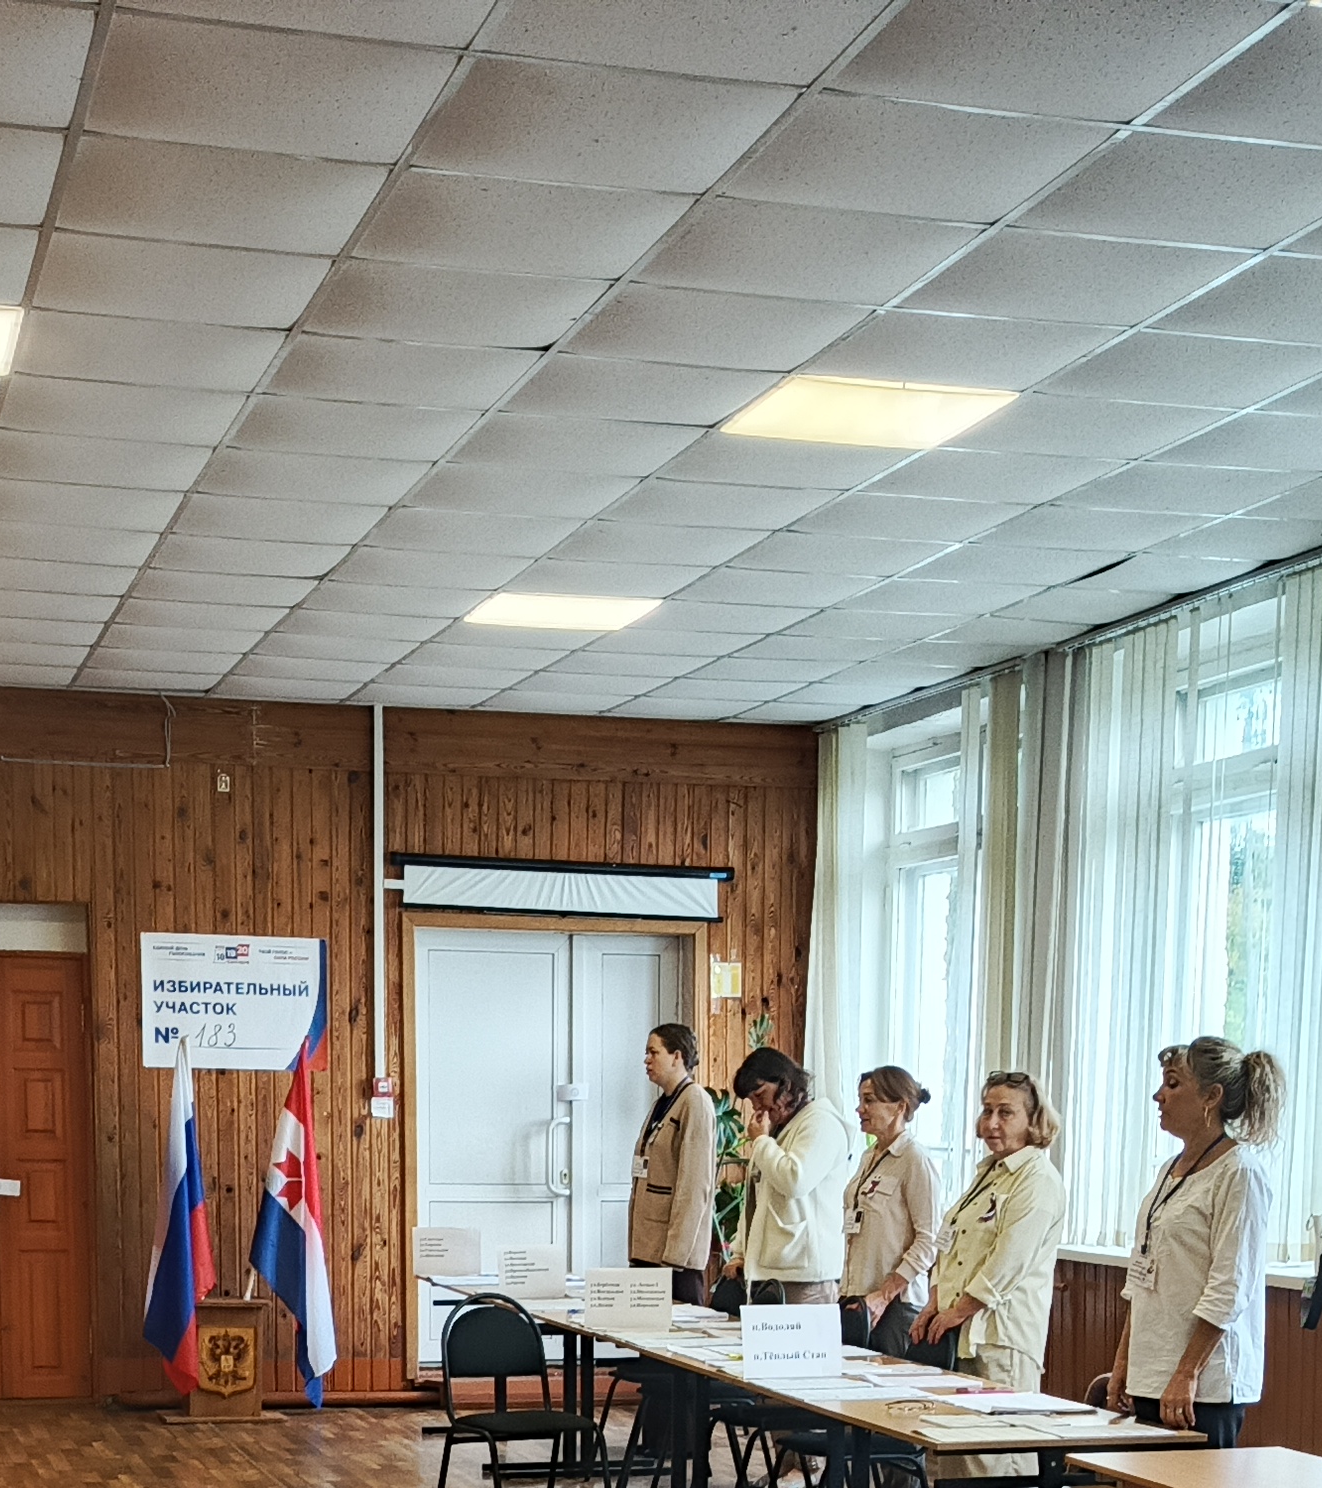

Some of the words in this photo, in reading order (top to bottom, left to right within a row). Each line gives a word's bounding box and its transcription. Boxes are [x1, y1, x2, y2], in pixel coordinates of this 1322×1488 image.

[237, 946, 248, 954] 20
[152, 980, 309, 998] ИЗБИРАТЕЛЬНЫЙ
[154, 1000, 237, 1016] УЧАСТОК
[154, 1026, 180, 1044] №
[195, 1023, 237, 1048] 183
[802, 1349, 827, 1360] Стан
